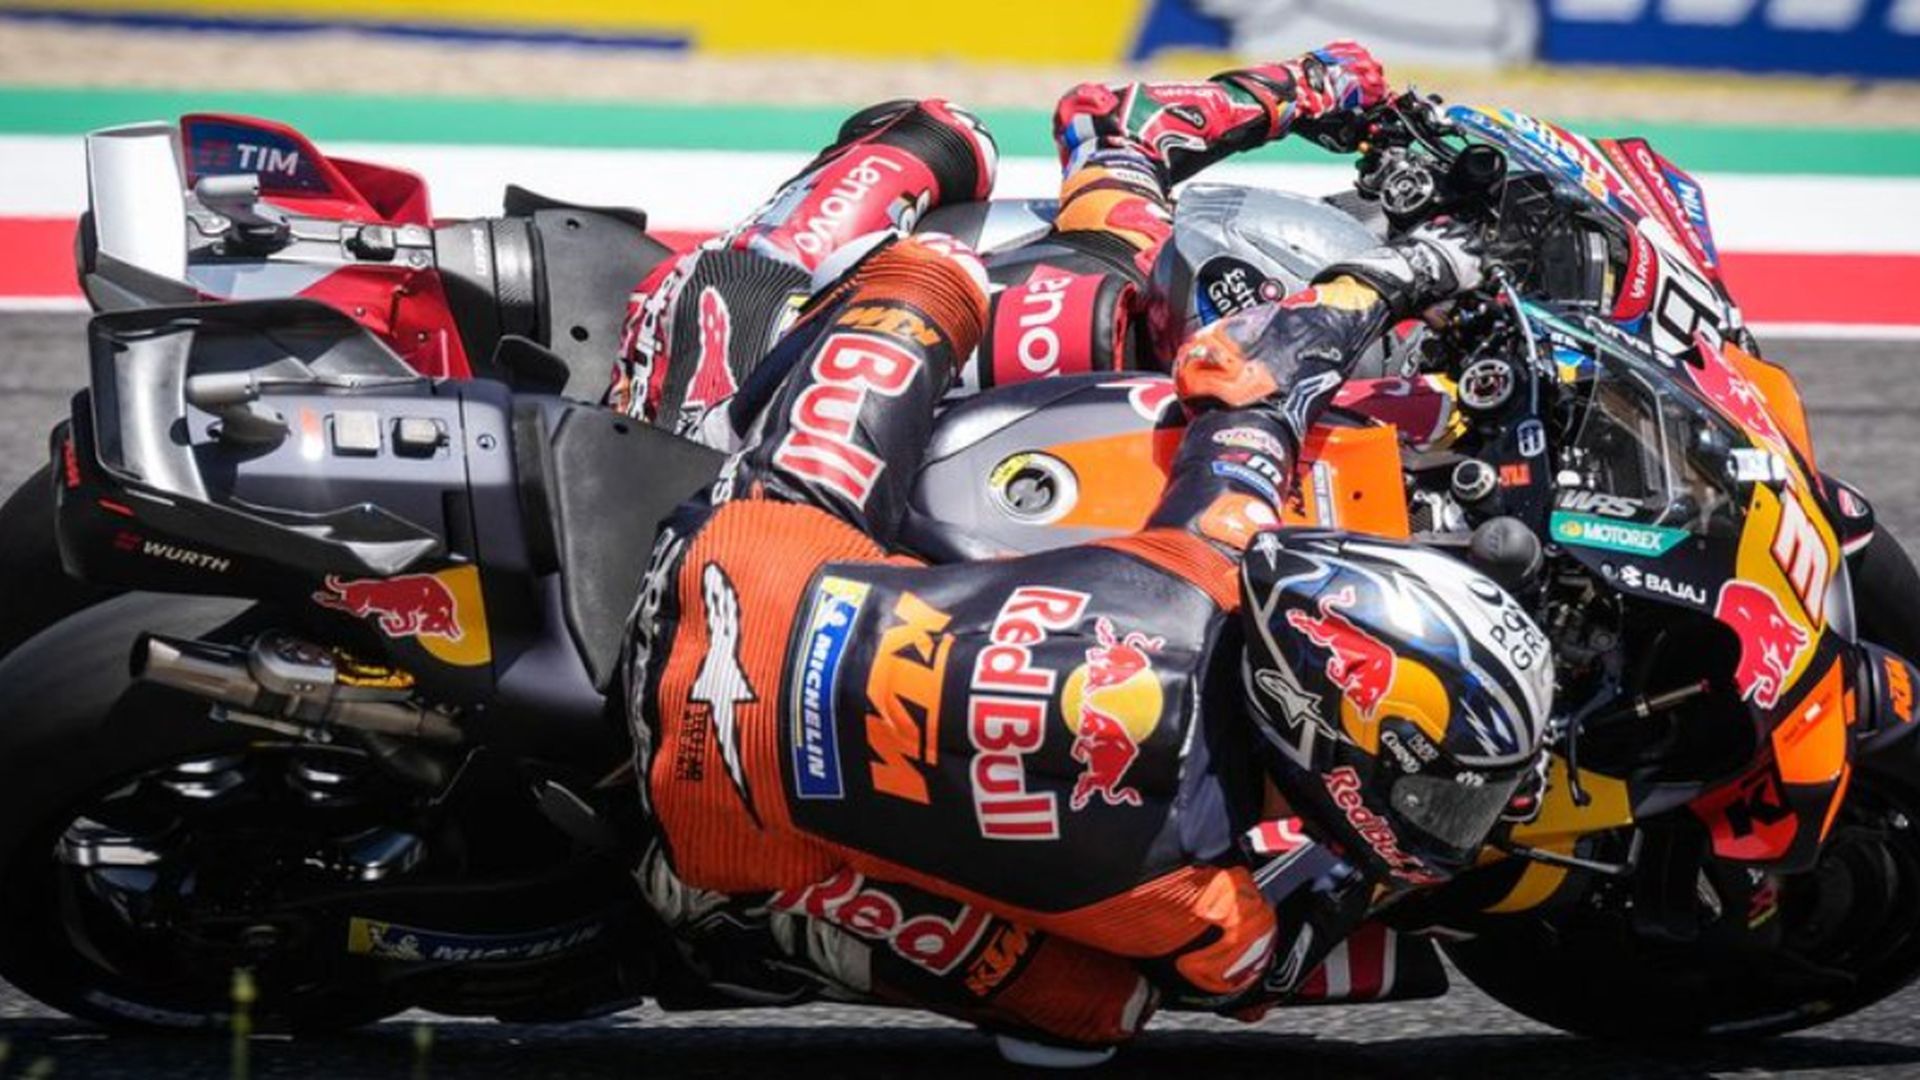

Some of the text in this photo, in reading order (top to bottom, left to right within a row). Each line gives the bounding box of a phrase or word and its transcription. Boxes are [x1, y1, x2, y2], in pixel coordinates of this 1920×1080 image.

[237, 143, 299, 176] TIM
[794, 155, 903, 255] Lenovo
[773, 332, 923, 513] Bull
[1556, 489, 1645, 518] WRS
[1582, 522, 1664, 551] MOTOREX
[1644, 572, 1707, 604] BAJAJ
[804, 631, 833, 780] MICHELIN
[865, 590, 956, 805] KTM
[760, 866, 994, 977] Red
